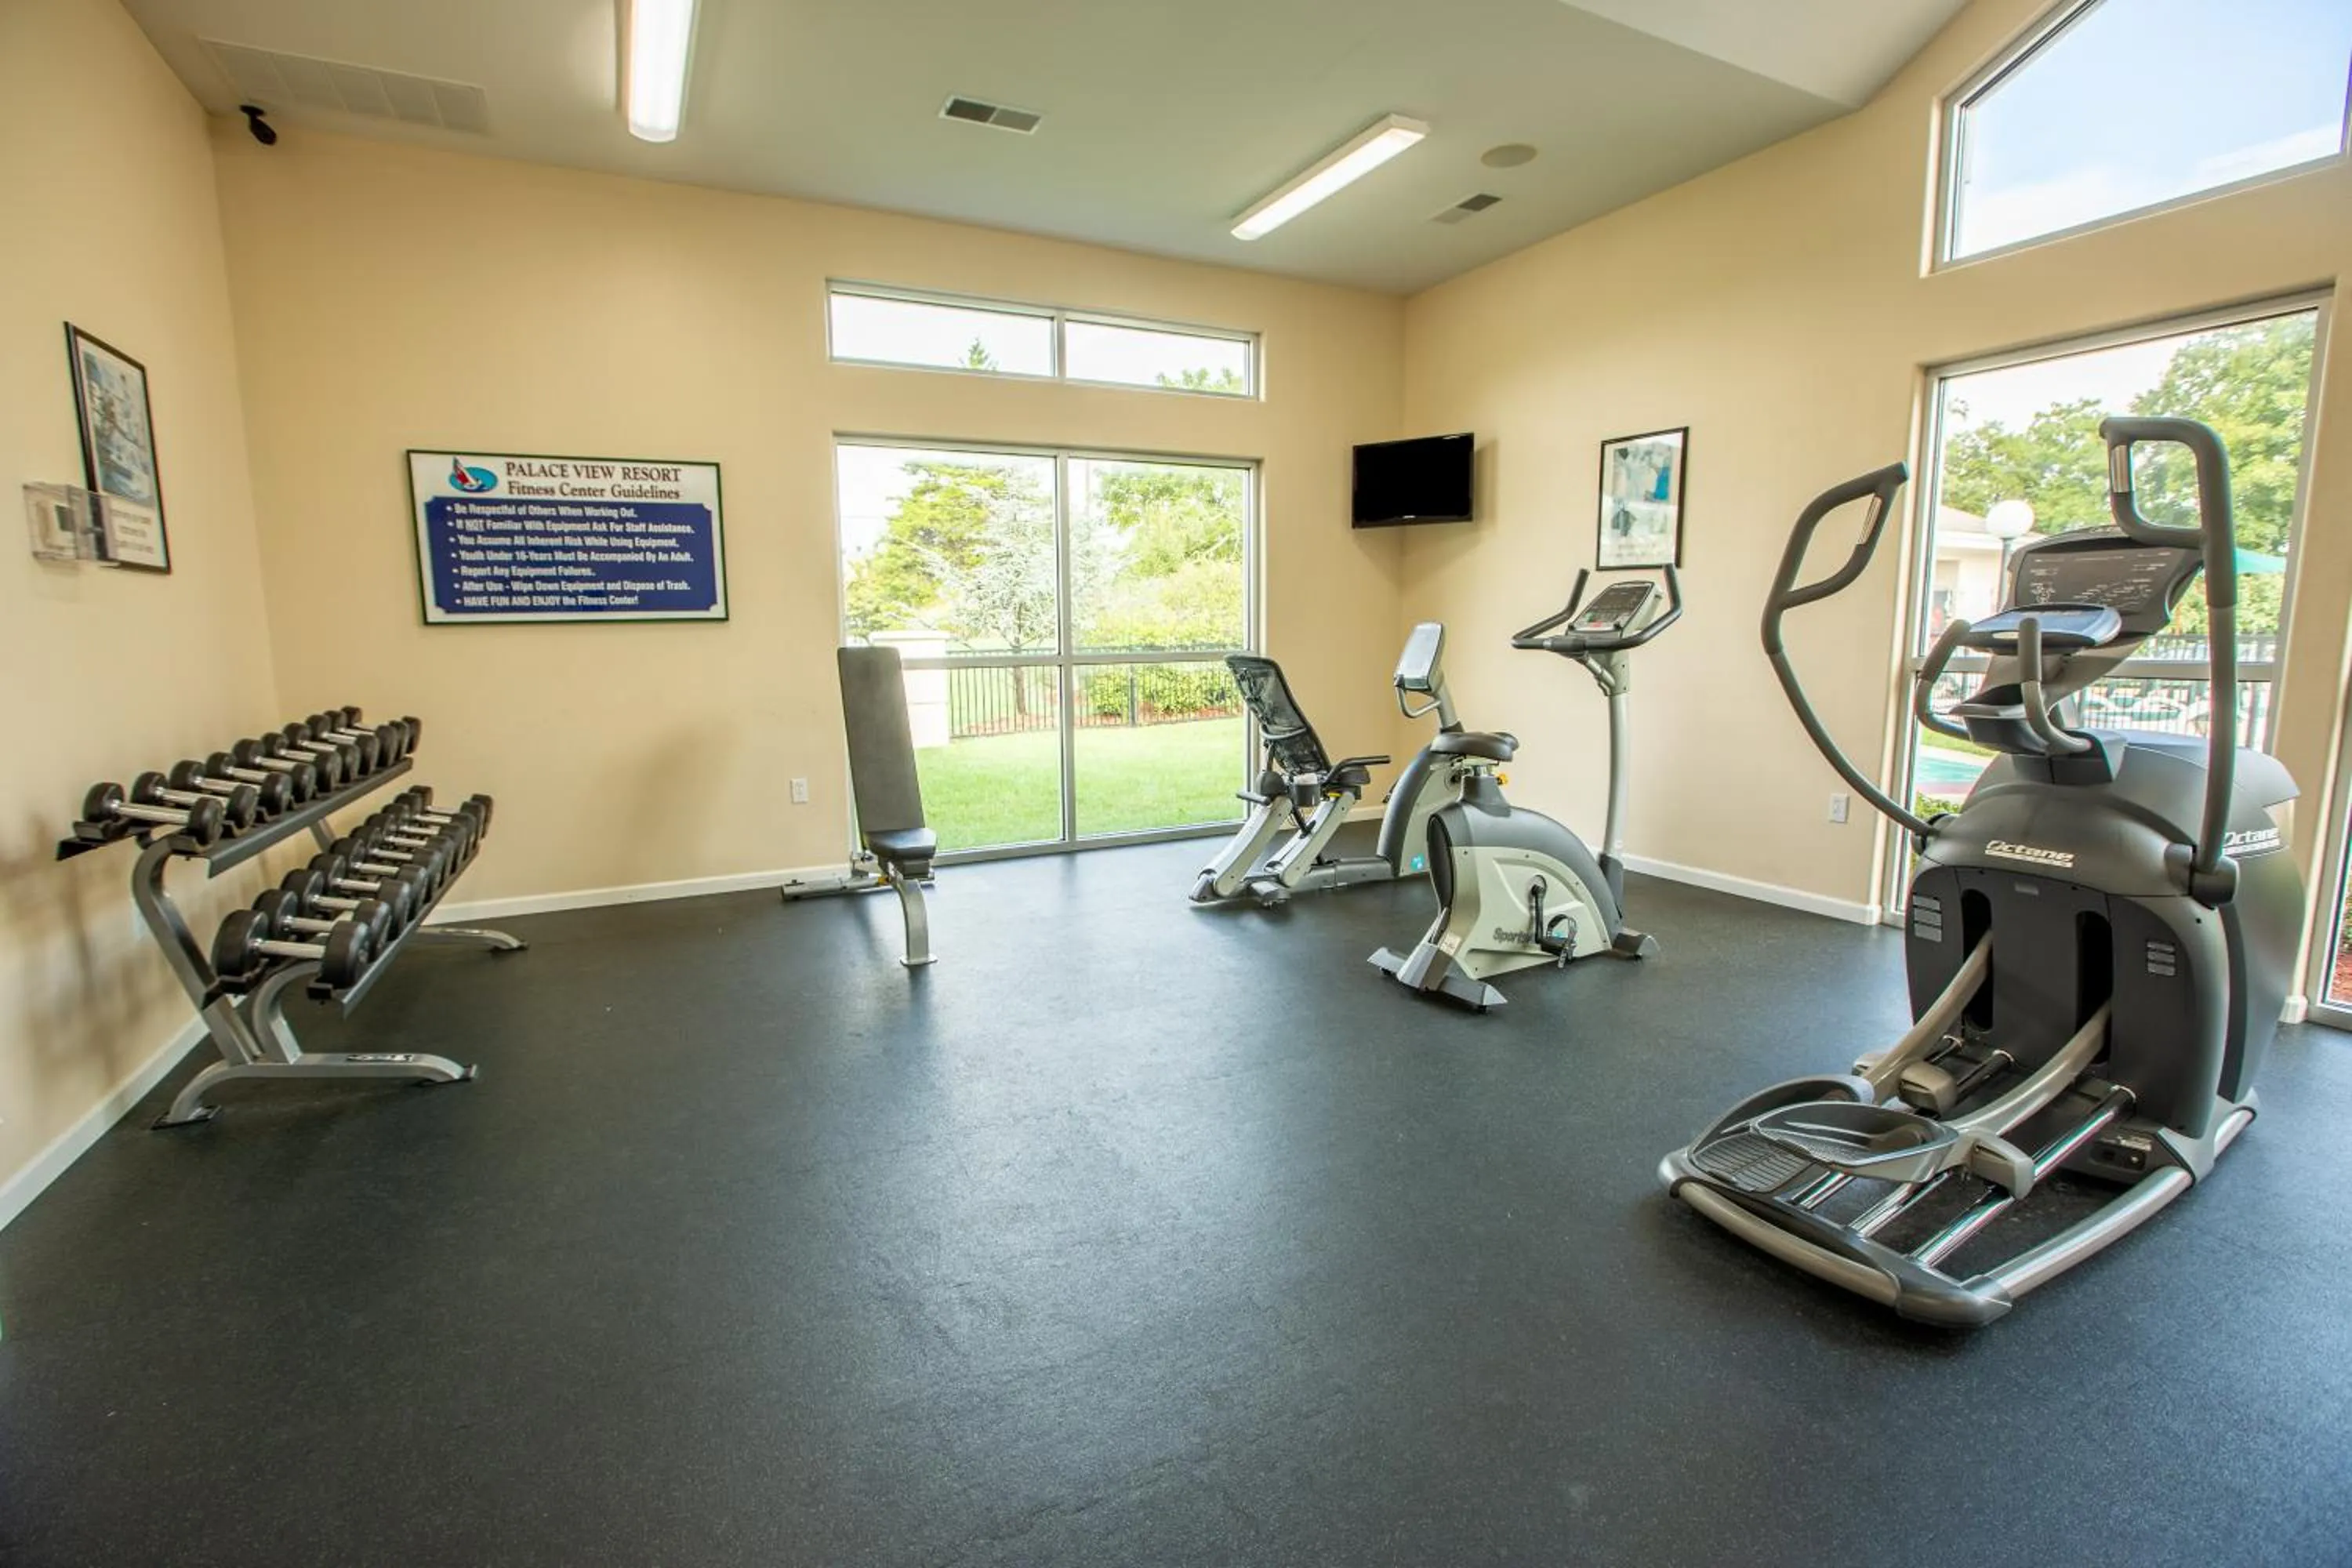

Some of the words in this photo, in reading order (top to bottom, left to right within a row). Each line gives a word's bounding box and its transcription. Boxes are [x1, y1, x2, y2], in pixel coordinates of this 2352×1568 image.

[505, 461, 569, 477] PALACE
[572, 463, 616, 479] VIEW
[621, 466, 682, 481] RESORT
[507, 481, 556, 495] Fitness
[559, 481, 605, 498] Center
[611, 483, 681, 499] Guidelines
[468, 503, 517, 515] Respectful
[517, 504, 527, 514] of
[528, 504, 557, 515] Others
[557, 505, 583, 517] When
[584, 506, 619, 519] Working
[619, 507, 639, 517] Out.
[464, 518, 485, 531] NOT
[485, 519, 523, 530] Familiar
[523, 520, 545, 531] With
[546, 521, 590, 533] Equipment
[592, 521, 608, 532] Ask
[609, 522, 624, 532] For
[625, 522, 647, 533] Staff
[476, 535, 513, 546] Assume
[564, 535, 583, 546] Risk
[584, 536, 608, 546] While
[609, 536, 633, 549] Using
[634, 537, 680, 549] Equipment.
[459, 550, 485, 561] Youth
[485, 550, 513, 561] Under
[554, 550, 575, 561] Must
[590, 551, 645, 563] Accompanied
[645, 551, 657, 563] By
[658, 551, 669, 561] An
[460, 565, 492, 577] Report
[493, 566, 510, 578] Any
[510, 566, 557, 578] Equipment
[462, 581, 485, 591] After
[485, 581, 504, 591] Use
[511, 581, 534, 593] Wipe
[535, 580, 560, 591] Down
[561, 581, 604, 592] Equipment
[606, 581, 622, 590] and
[622, 581, 655, 593] Dispose
[656, 580, 665, 590] of
[463, 596, 490, 606] HAVE
[490, 596, 510, 606] FUN
[511, 596, 531, 606] AND
[532, 596, 561, 606] ENJOY
[562, 596, 576, 605] the
[578, 595, 608, 605] Fitness
[2221, 827, 2280, 846] Octane
[1985, 840, 2075, 862] Octane
